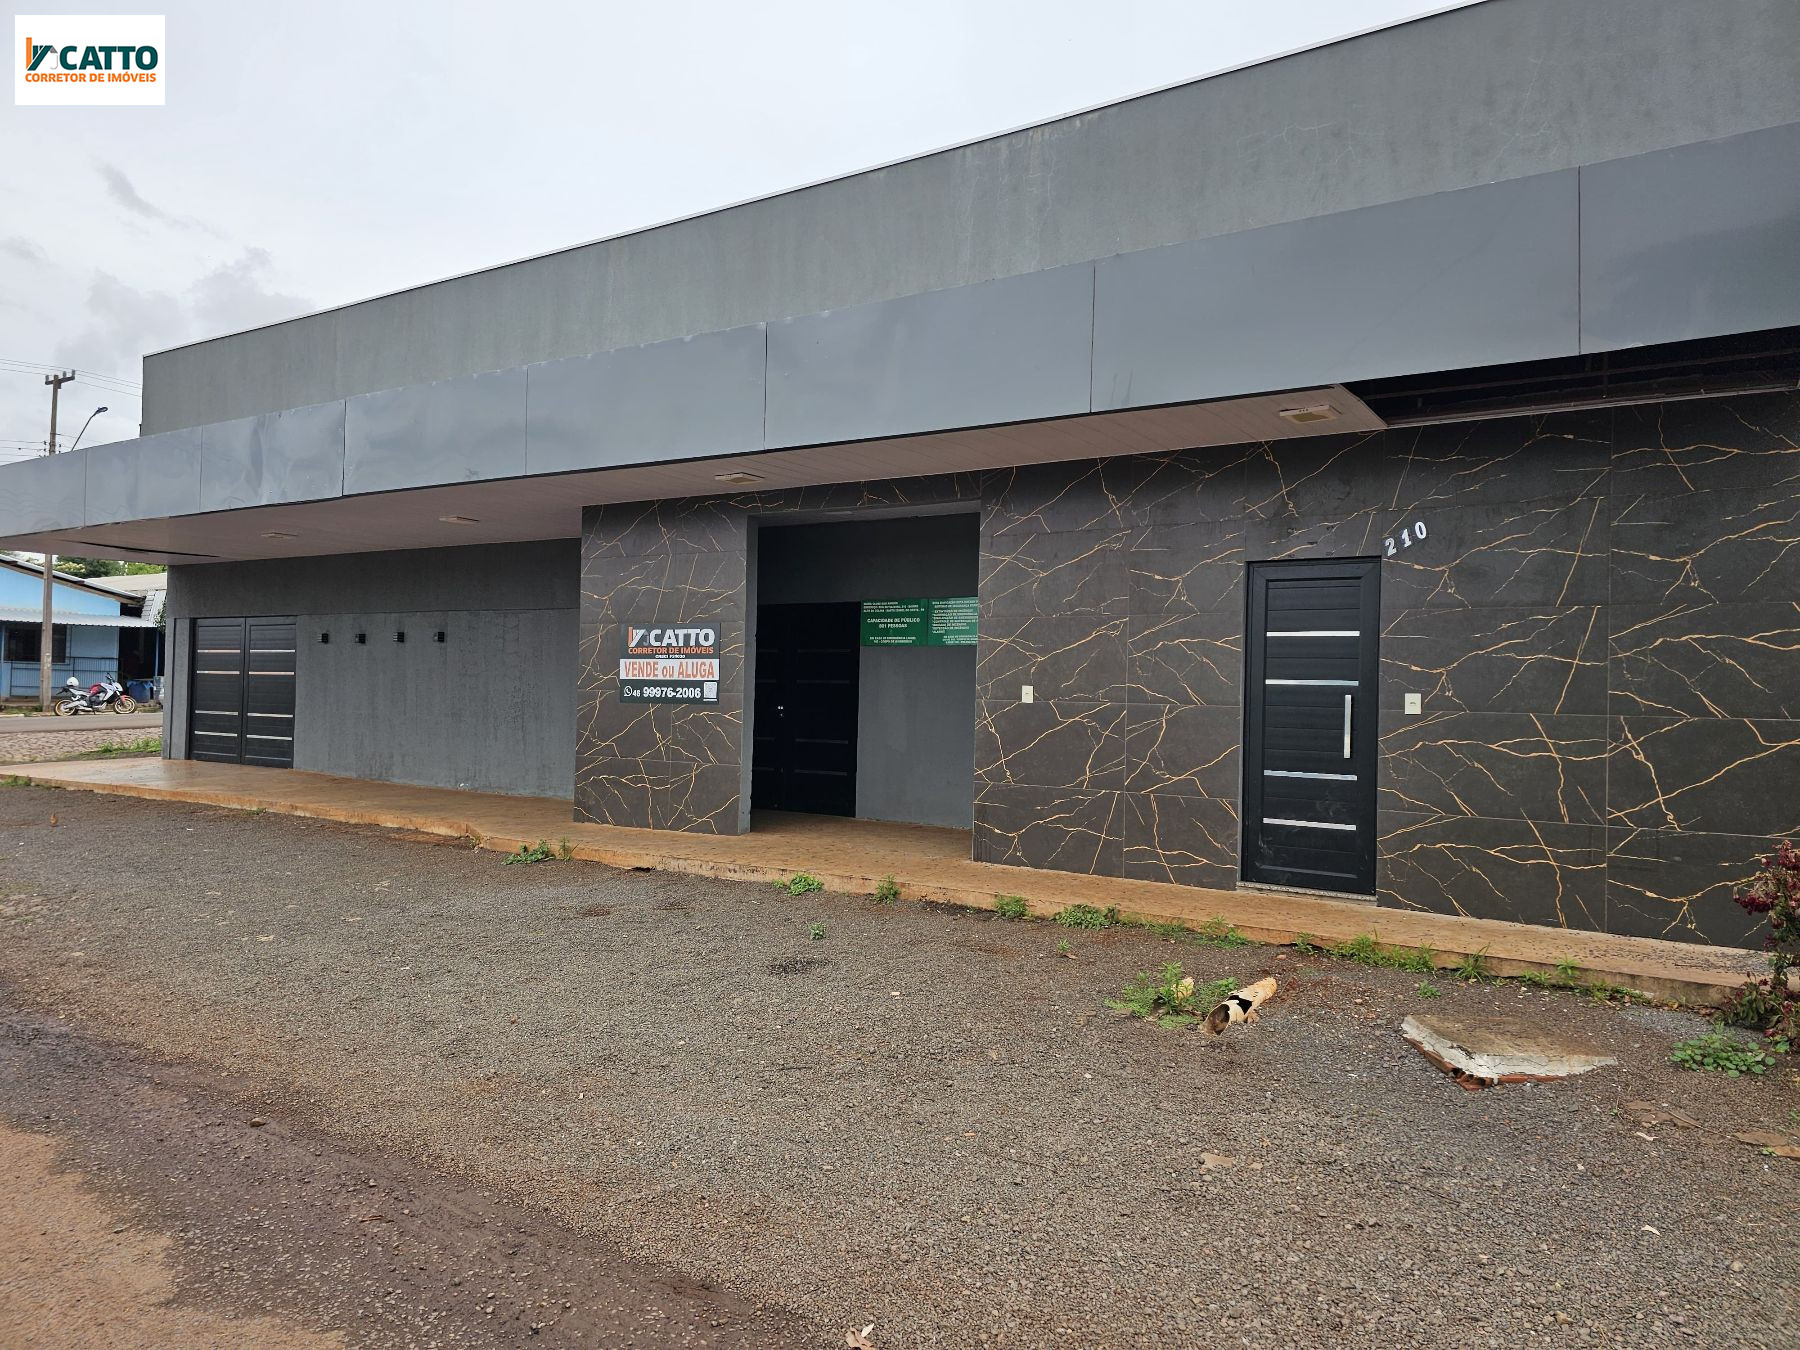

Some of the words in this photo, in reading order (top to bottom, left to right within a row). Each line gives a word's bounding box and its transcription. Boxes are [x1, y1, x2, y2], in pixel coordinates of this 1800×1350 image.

[1385, 521, 1427, 556] 210
[680, 646, 714, 654] IMÓVEIS
[624, 661, 659, 677] VENDE
[661, 665, 674, 678] ou
[677, 661, 715, 678] ALUGA
[643, 687, 701, 698] 99976-2006
